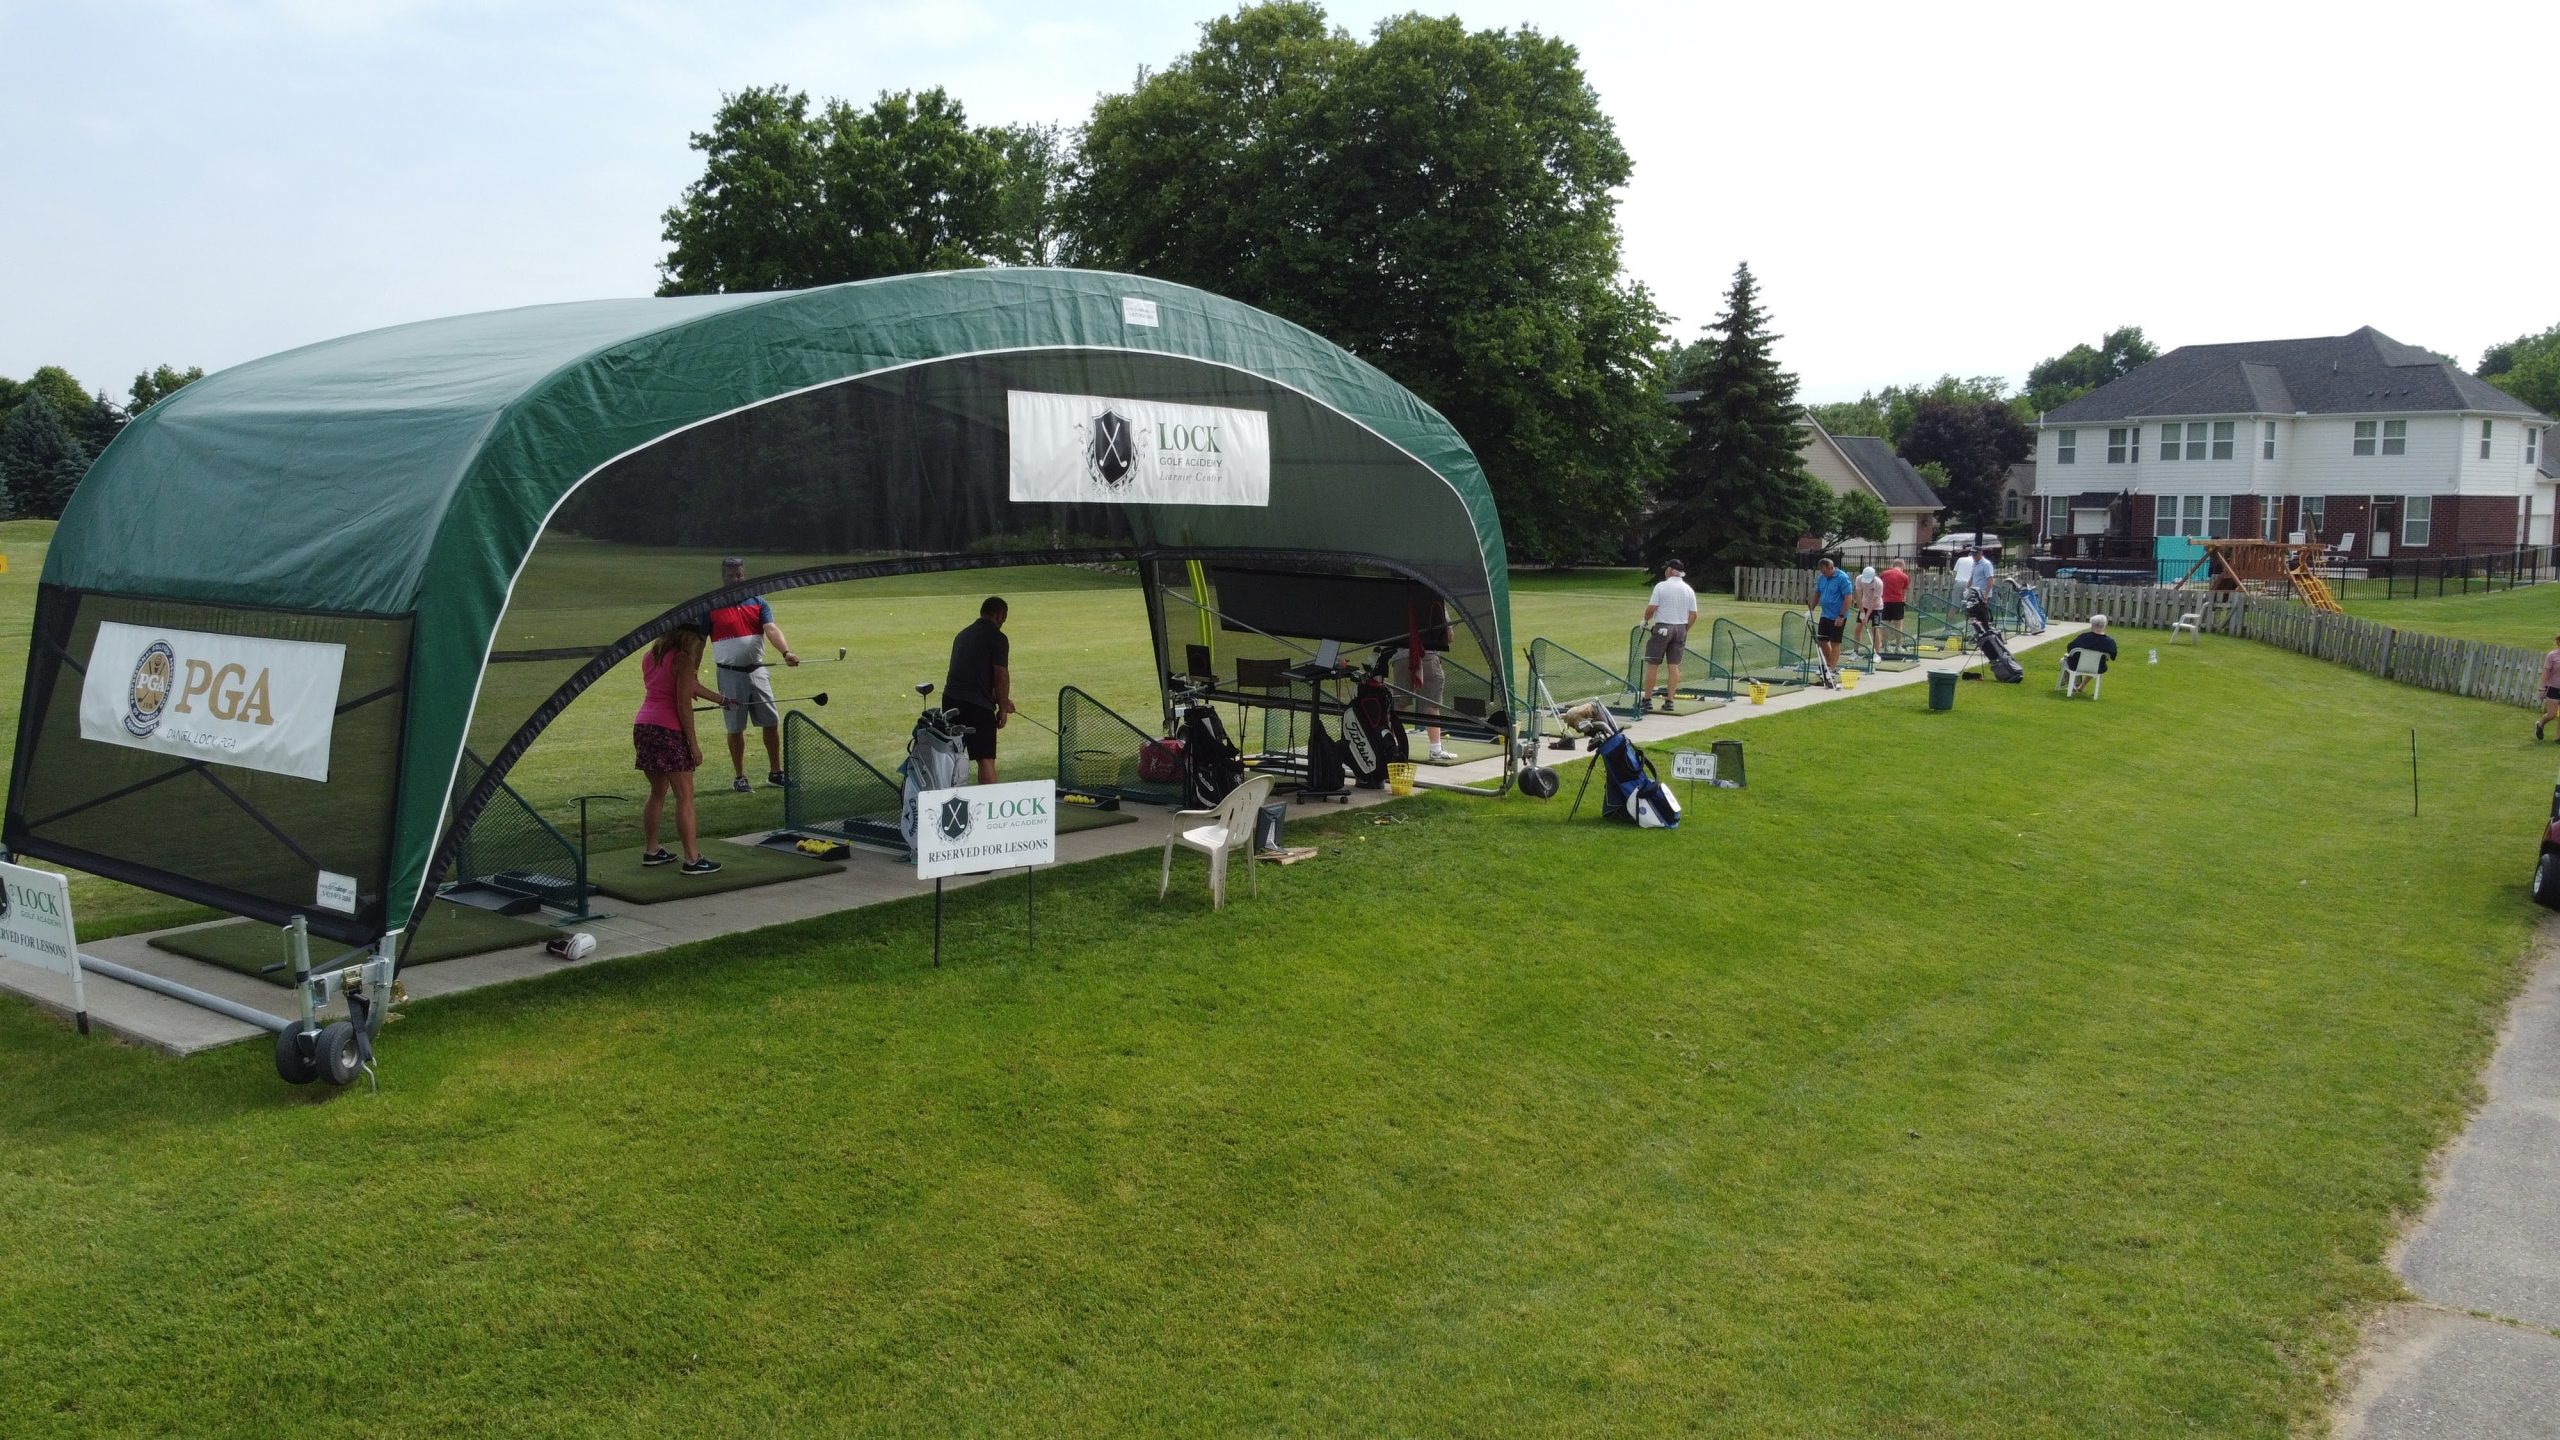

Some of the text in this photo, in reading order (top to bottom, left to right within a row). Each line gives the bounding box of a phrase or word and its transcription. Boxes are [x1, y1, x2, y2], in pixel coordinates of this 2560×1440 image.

[1158, 423, 1222, 453] LOCK
[1159, 457, 1183, 466] GOLF
[137, 673, 165, 693] PGA
[174, 659, 275, 726] PGA
[1345, 721, 1374, 768] Titleist
[1677, 766, 1711, 776] MATS ONLY
[1682, 757, 1707, 766] TEE OFF
[987, 796, 1047, 820] LOCK
[986, 818, 1048, 830] GOLF ACADEMY
[928, 838, 1049, 863] RESERVED FOR LESSONS
[16, 885, 59, 917] LOCK
[20, 910, 62, 928] GOLF ACADEMY
[20, 933, 35, 949] FOR
[36, 938, 67, 958] LESSONS
